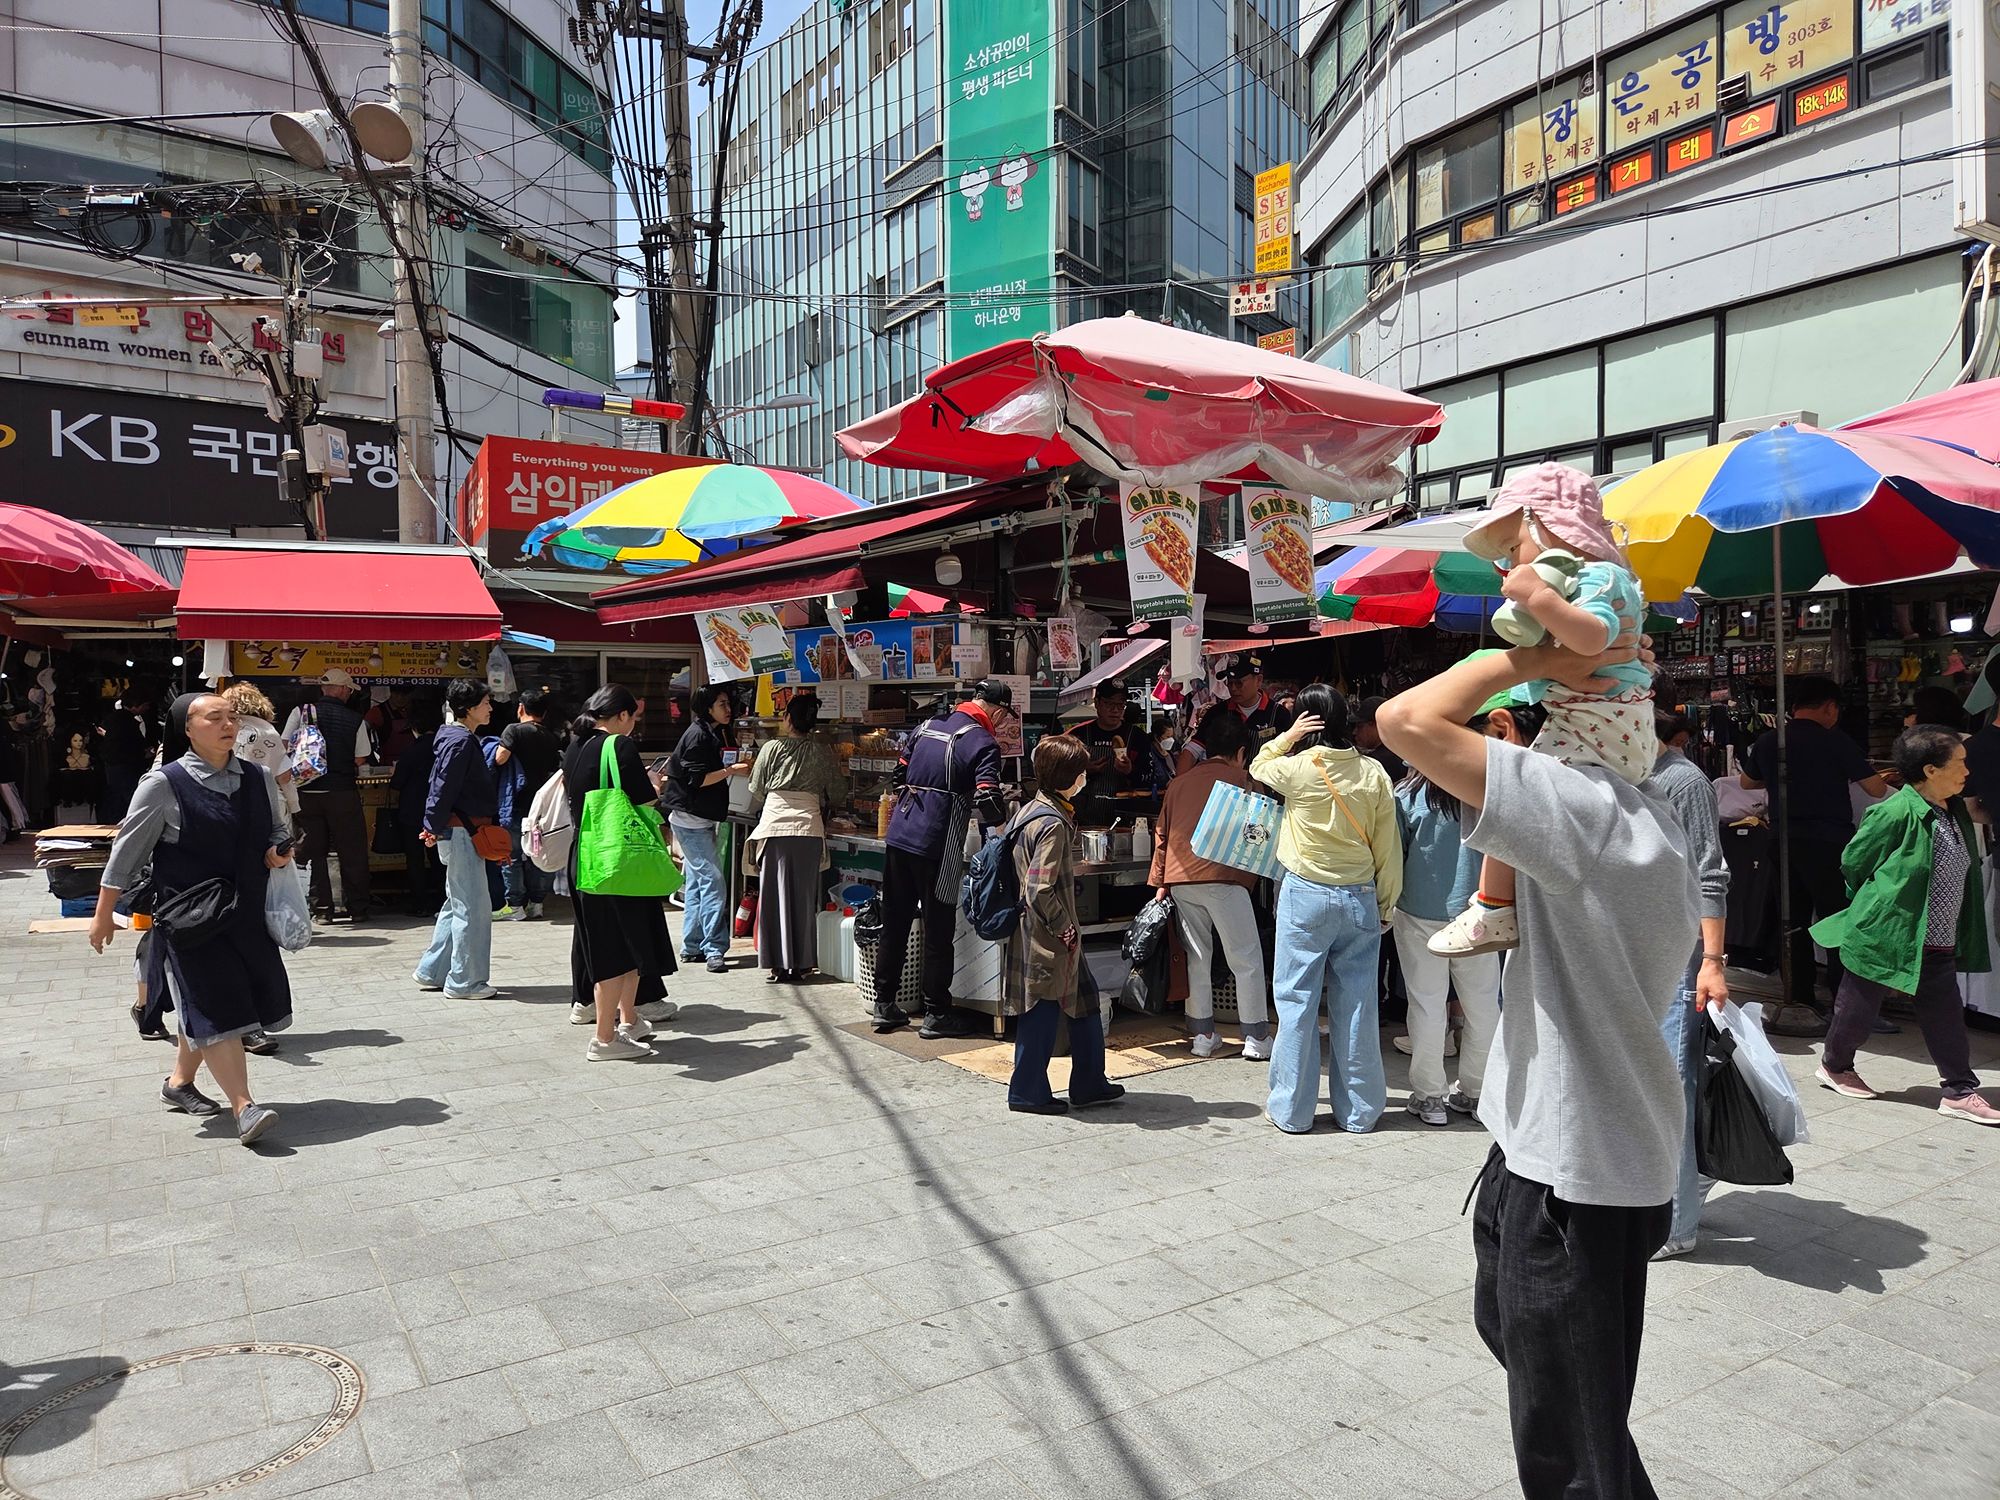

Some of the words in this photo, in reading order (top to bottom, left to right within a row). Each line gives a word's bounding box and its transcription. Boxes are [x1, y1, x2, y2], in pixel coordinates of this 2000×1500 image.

[1788, 16, 1832, 47] 303호
[963, 32, 1030, 73] 소상공인의
[961, 72, 989, 101] 평생
[992, 60, 1033, 90] 파트너
[1257, 172, 1278, 186] Money
[1257, 177, 1289, 194] Exchange
[975, 305, 1021, 329] 하나은행
[23, 328, 111, 353] eunnam
[118, 342, 192, 364] women
[51, 409, 161, 465] KB
[188, 423, 399, 489] 국민행
[512, 452, 588, 472] Everything
[591, 463, 617, 474] you
[620, 466, 654, 477] want
[1135, 600, 1164, 610] Vegetable
[1256, 603, 1282, 613] Vegetable
[352, 677, 439, 685] 10-9895-0333
